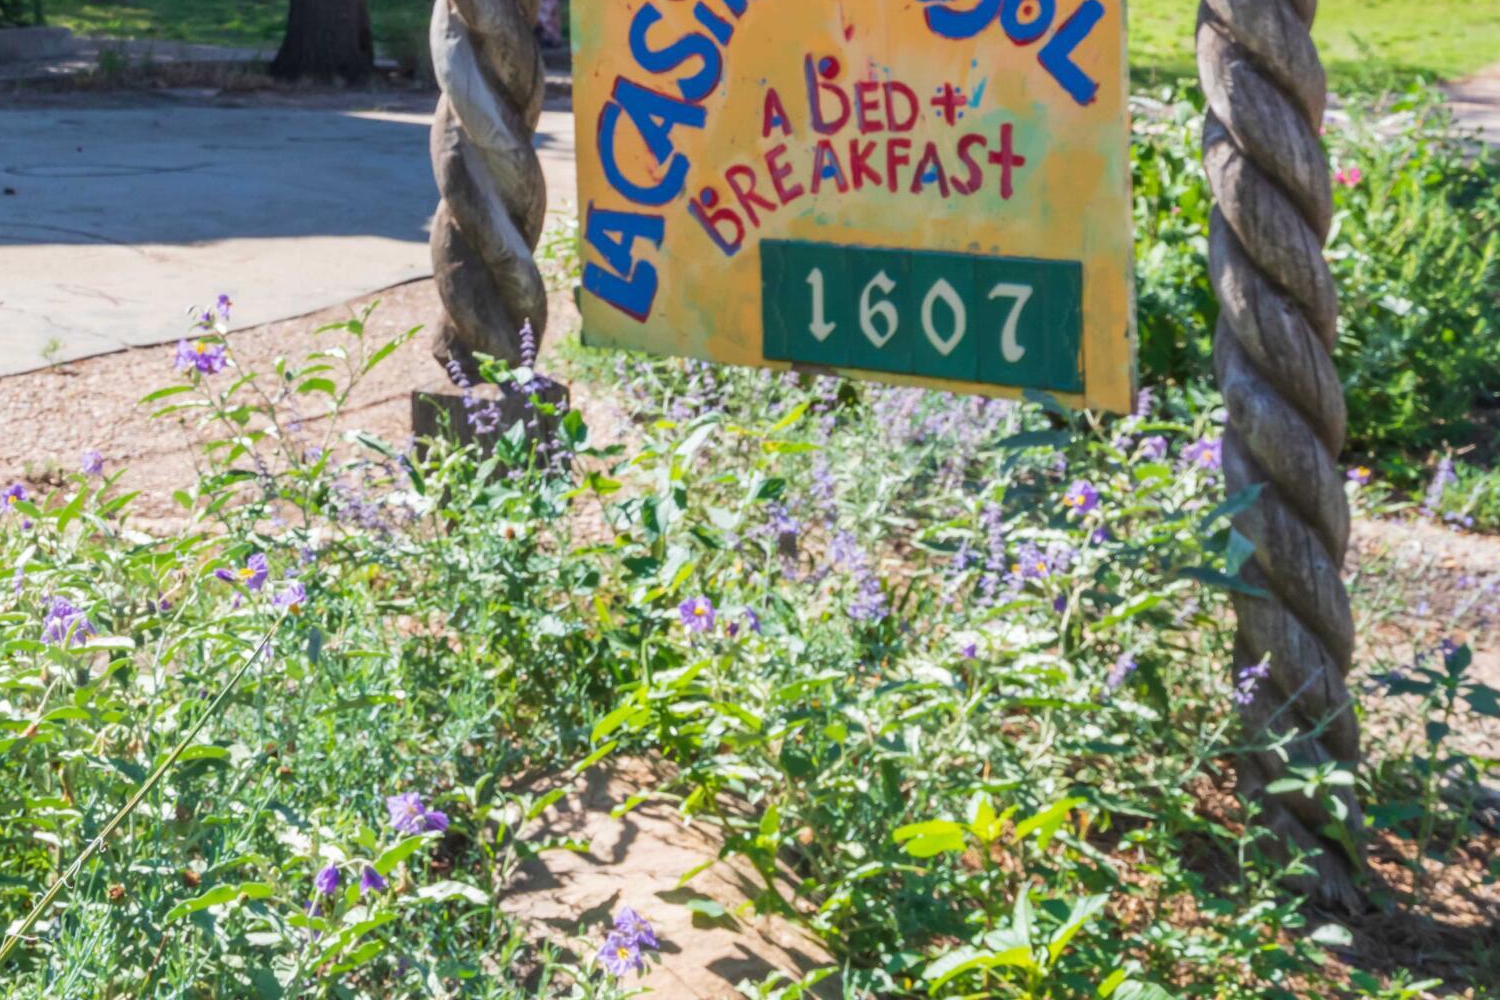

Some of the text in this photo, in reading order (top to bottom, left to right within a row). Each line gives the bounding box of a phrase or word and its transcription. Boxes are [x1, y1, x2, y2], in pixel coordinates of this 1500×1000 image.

[762, 87, 792, 138] A
[805, 52, 920, 135] BED
[582, 200, 666, 324] LA
[805, 267, 1034, 363] 1607
